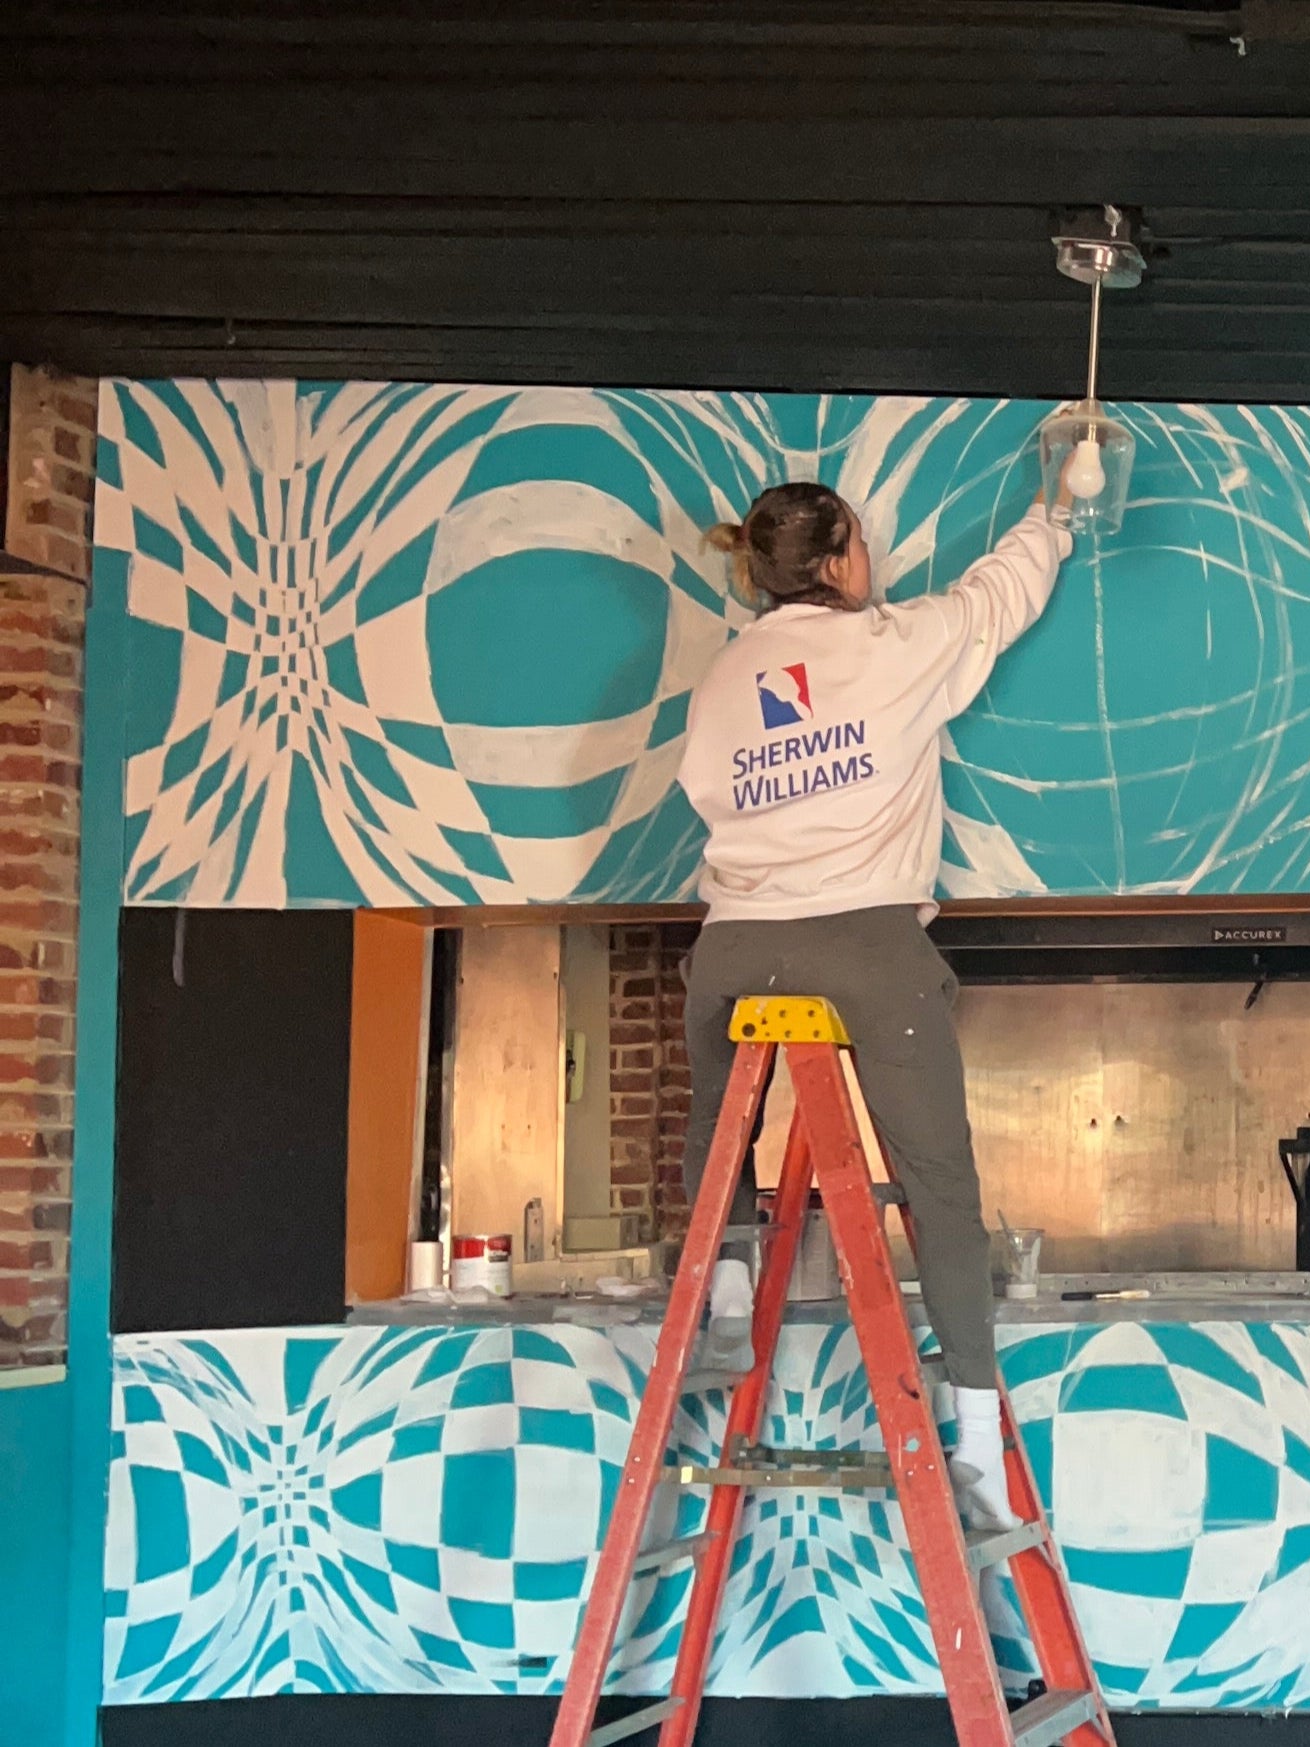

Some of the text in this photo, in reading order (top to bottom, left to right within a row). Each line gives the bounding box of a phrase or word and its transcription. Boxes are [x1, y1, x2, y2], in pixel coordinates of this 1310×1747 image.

[733, 720, 865, 779] SHERWIN
[733, 753, 874, 810] WILLIAMS
[1225, 930, 1282, 940] ACCUREX
